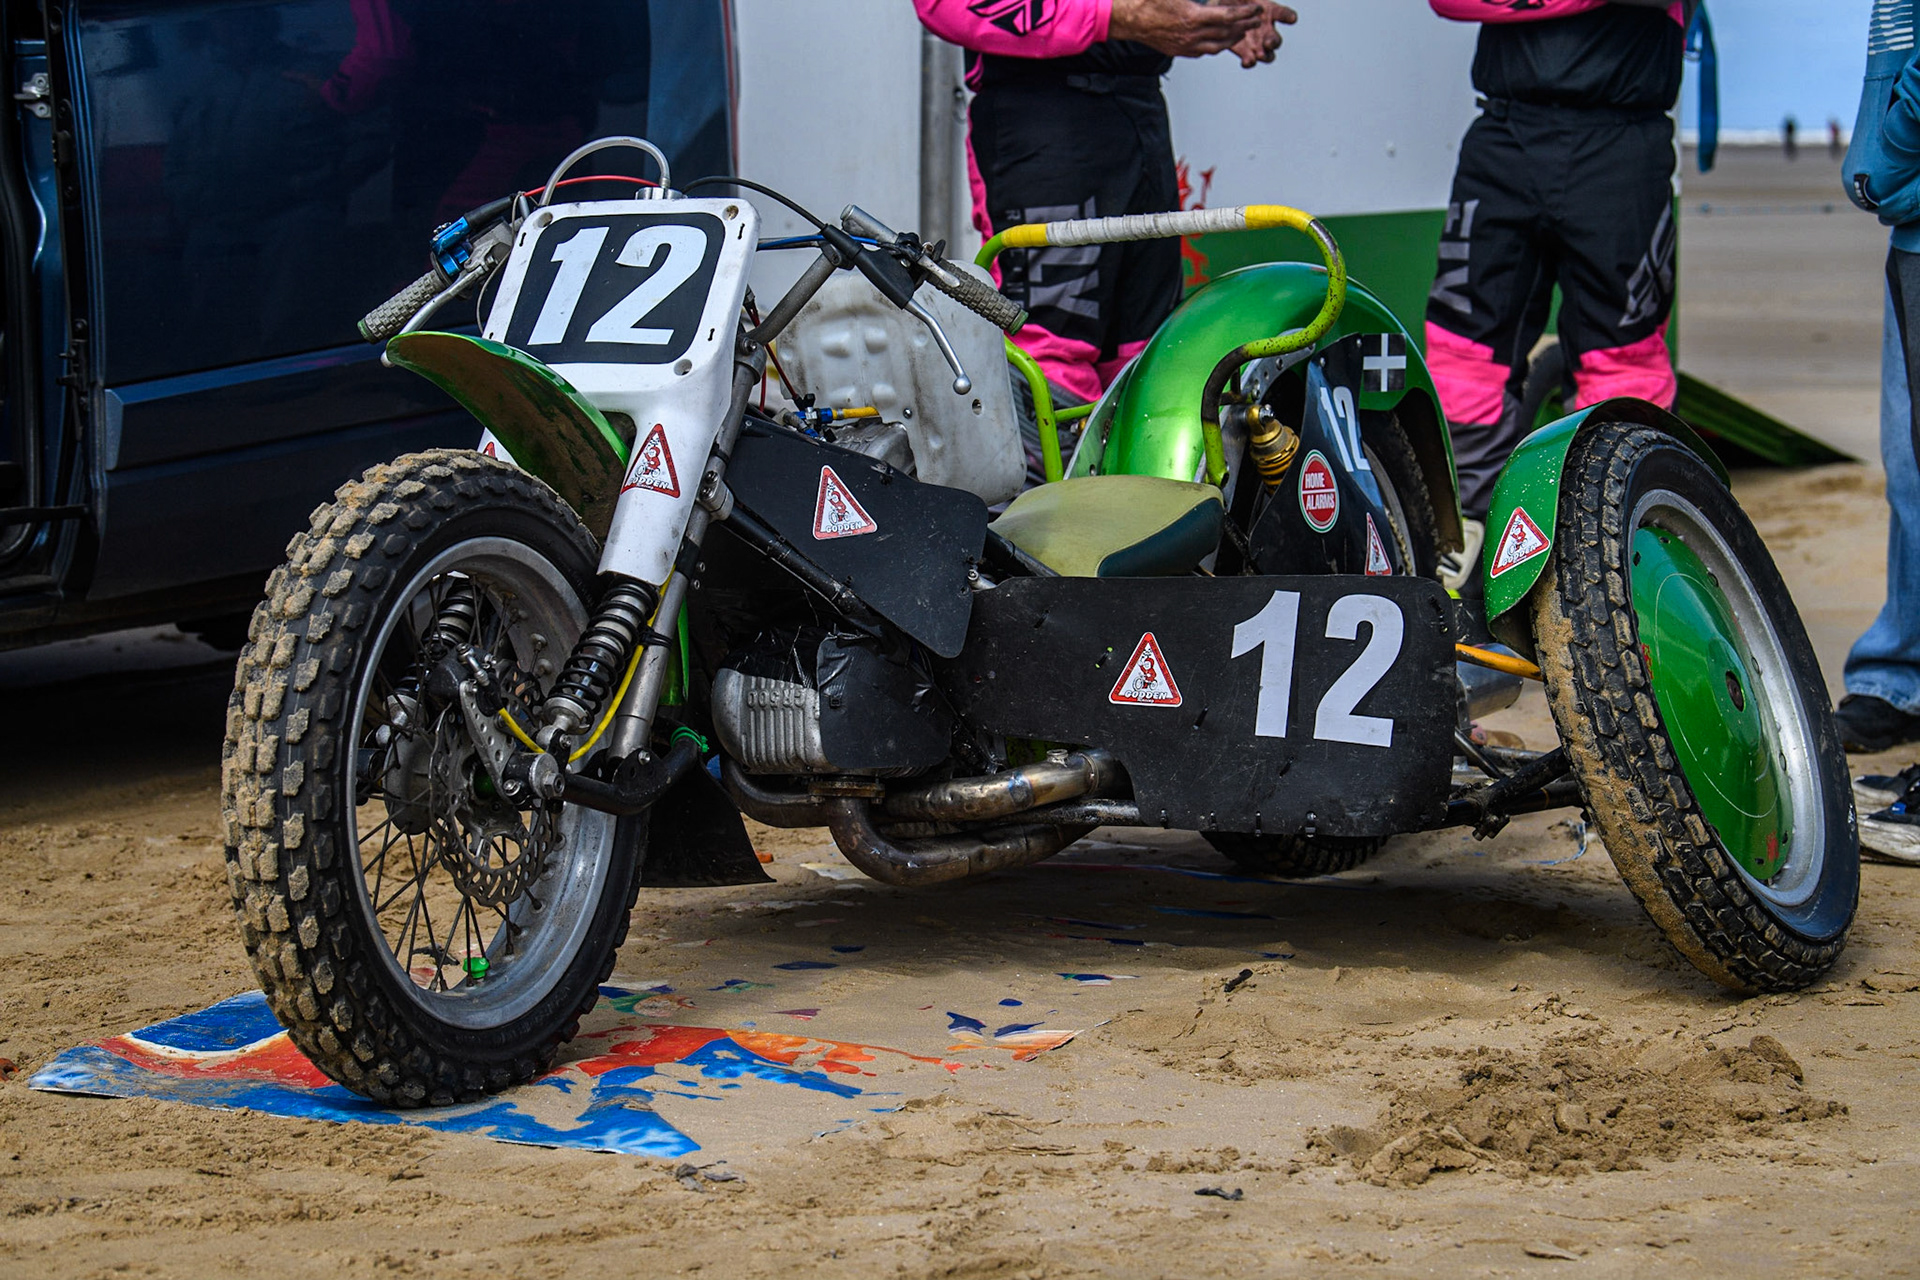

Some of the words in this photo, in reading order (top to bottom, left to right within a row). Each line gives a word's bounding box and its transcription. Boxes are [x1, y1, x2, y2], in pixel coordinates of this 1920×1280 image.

[527, 224, 708, 345] 12
[1320, 386, 1371, 472] 12
[1304, 472, 1325, 489] HOME
[1305, 493, 1335, 511] ALARMS
[825, 521, 862, 533] GODDEN
[1230, 590, 1405, 748] 12
[1124, 690, 1167, 700] GODDEN
